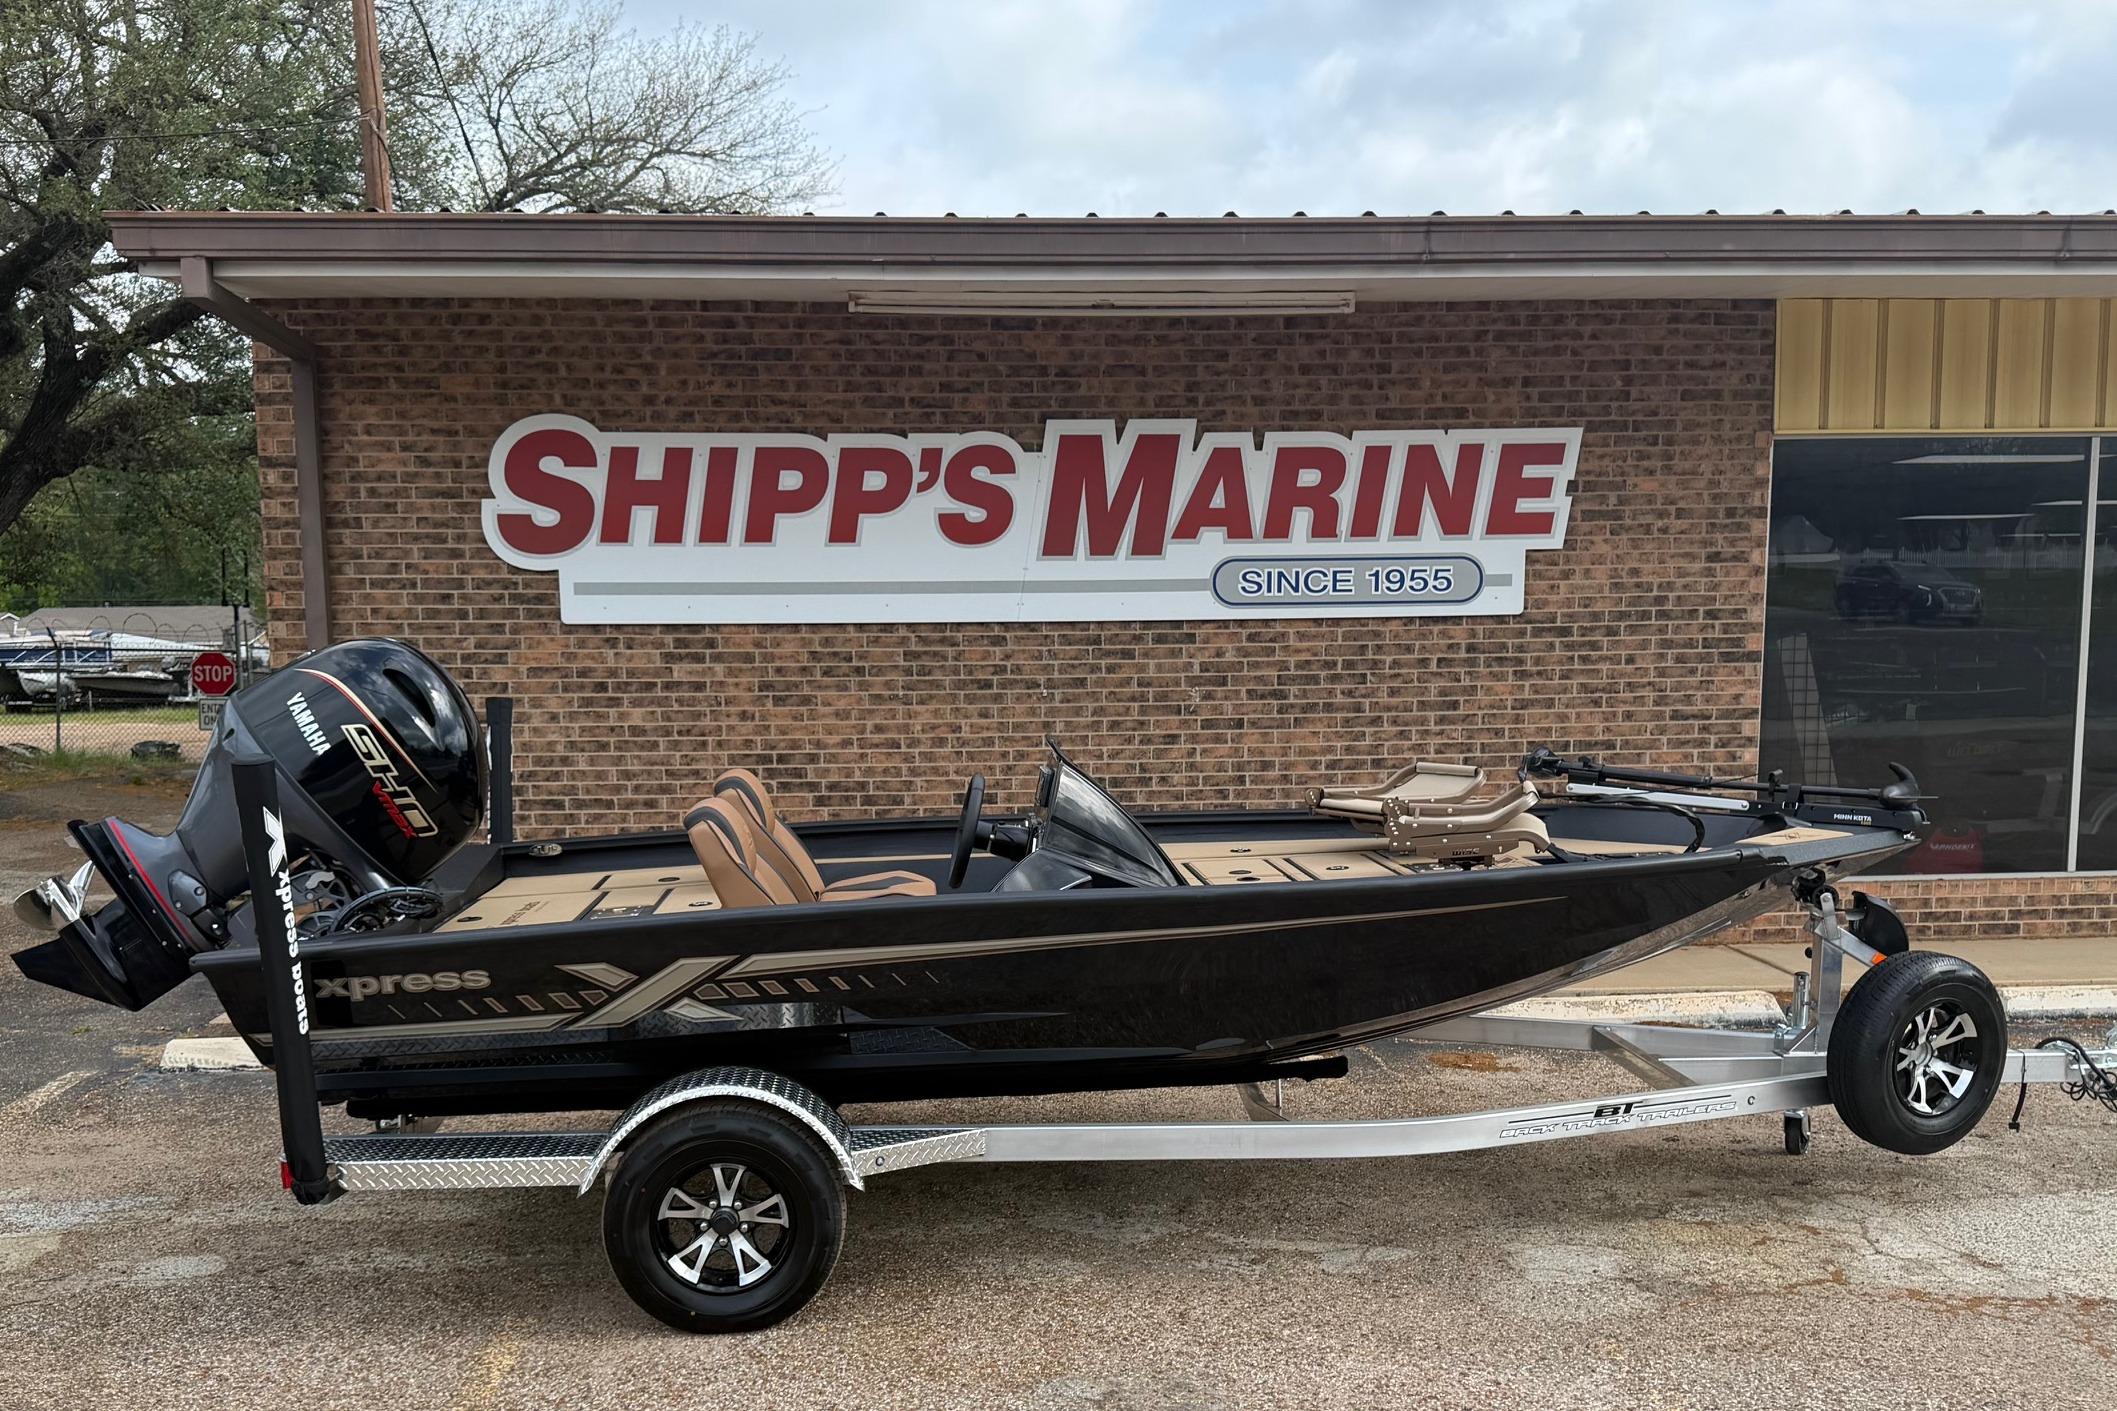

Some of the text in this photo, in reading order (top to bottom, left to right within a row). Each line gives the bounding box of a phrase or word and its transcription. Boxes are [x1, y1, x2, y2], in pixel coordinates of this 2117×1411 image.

[496, 428, 1568, 557] SHIPP'S MARINE
[1239, 566, 1454, 596] SINCE 1955
[194, 665, 232, 682] STOP
[287, 691, 332, 756] YAMAHA
[1833, 813, 1853, 821] MINN
[275, 870, 310, 1036] xpress boats
[314, 969, 492, 1002] xpress
[1500, 1101, 1737, 1139] BACK TRACK TRAILERS
[1593, 1101, 1643, 1118] BT
